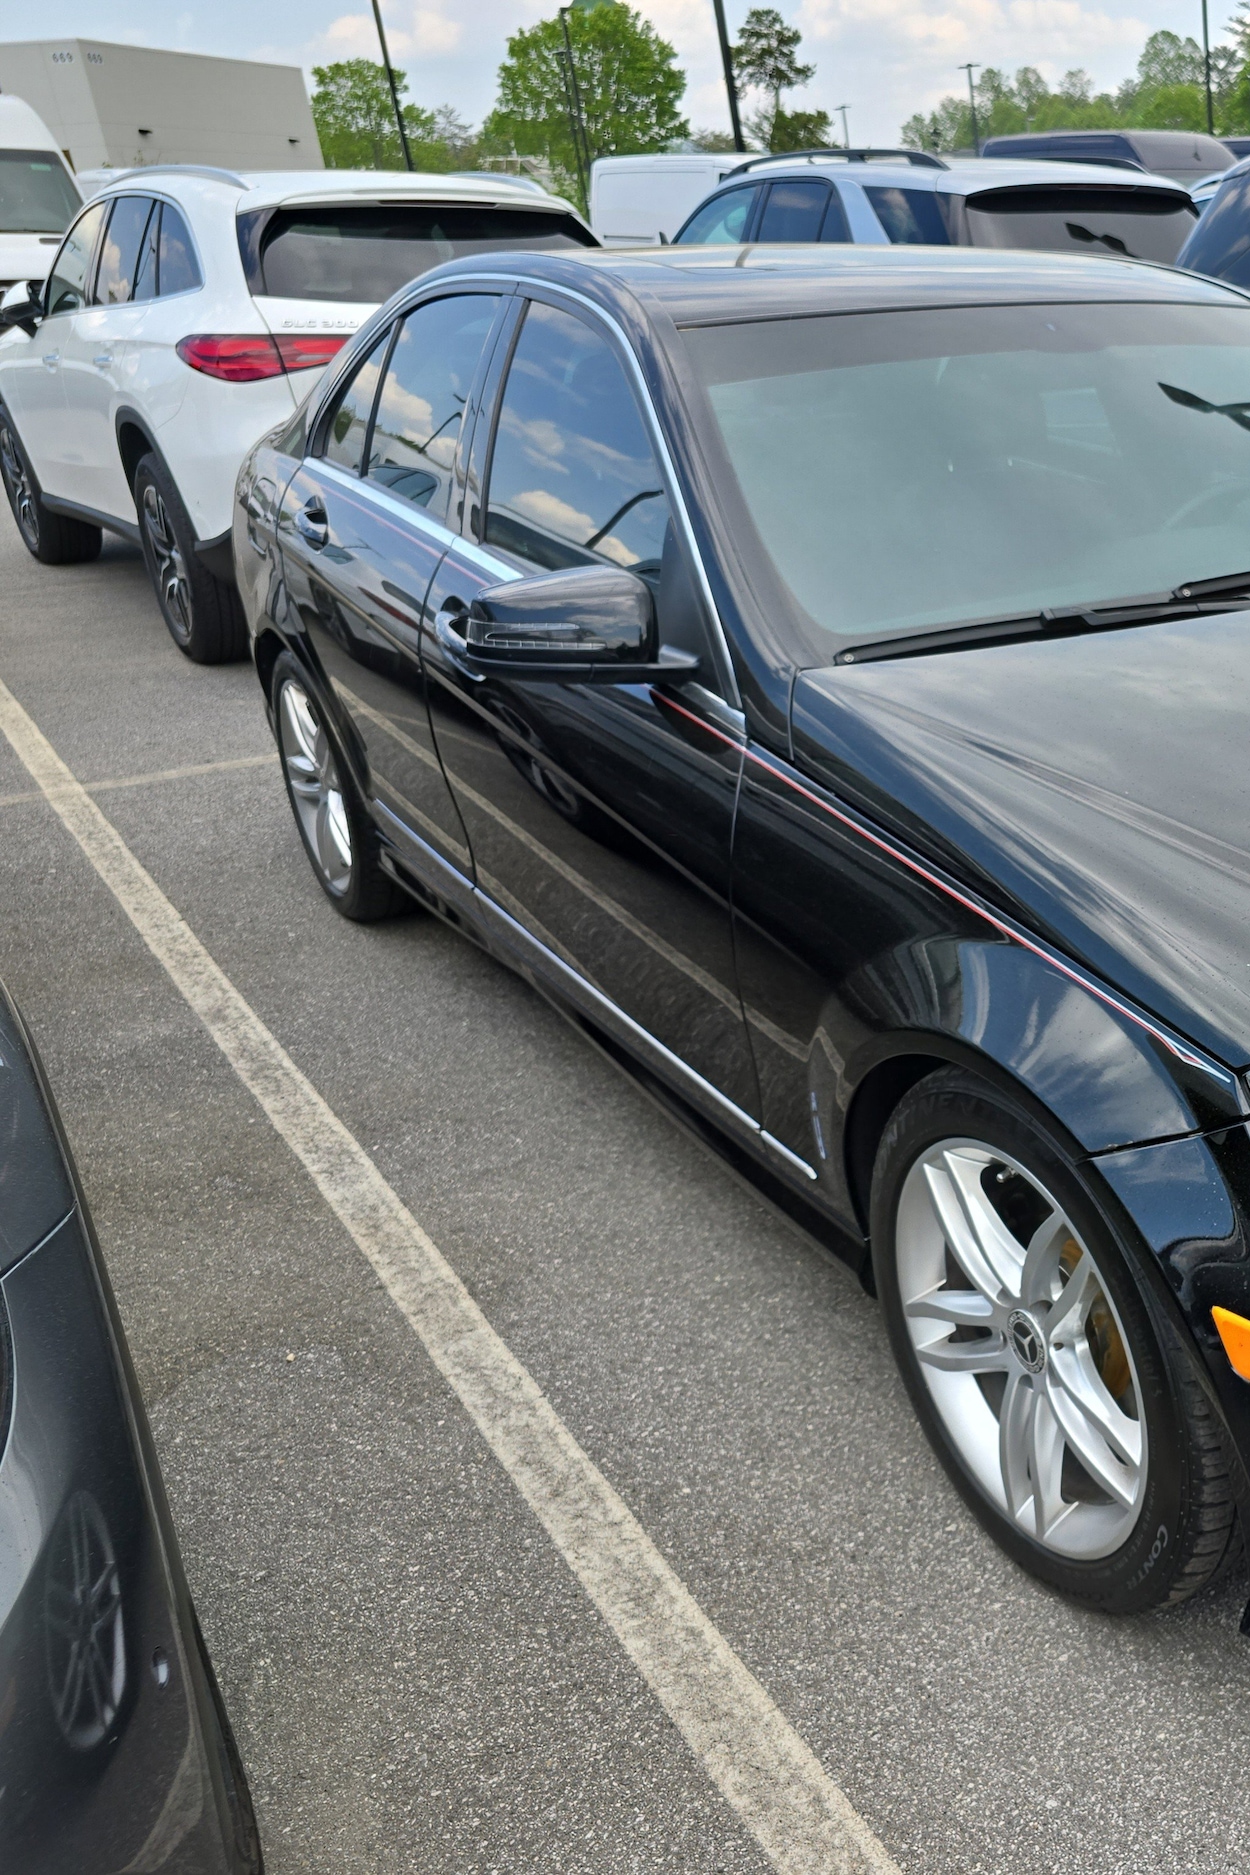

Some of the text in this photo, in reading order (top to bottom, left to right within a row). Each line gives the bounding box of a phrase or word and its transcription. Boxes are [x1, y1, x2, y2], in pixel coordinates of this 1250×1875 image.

[52, 52, 73, 63] 669
[281, 319, 358, 328] GLC 300
